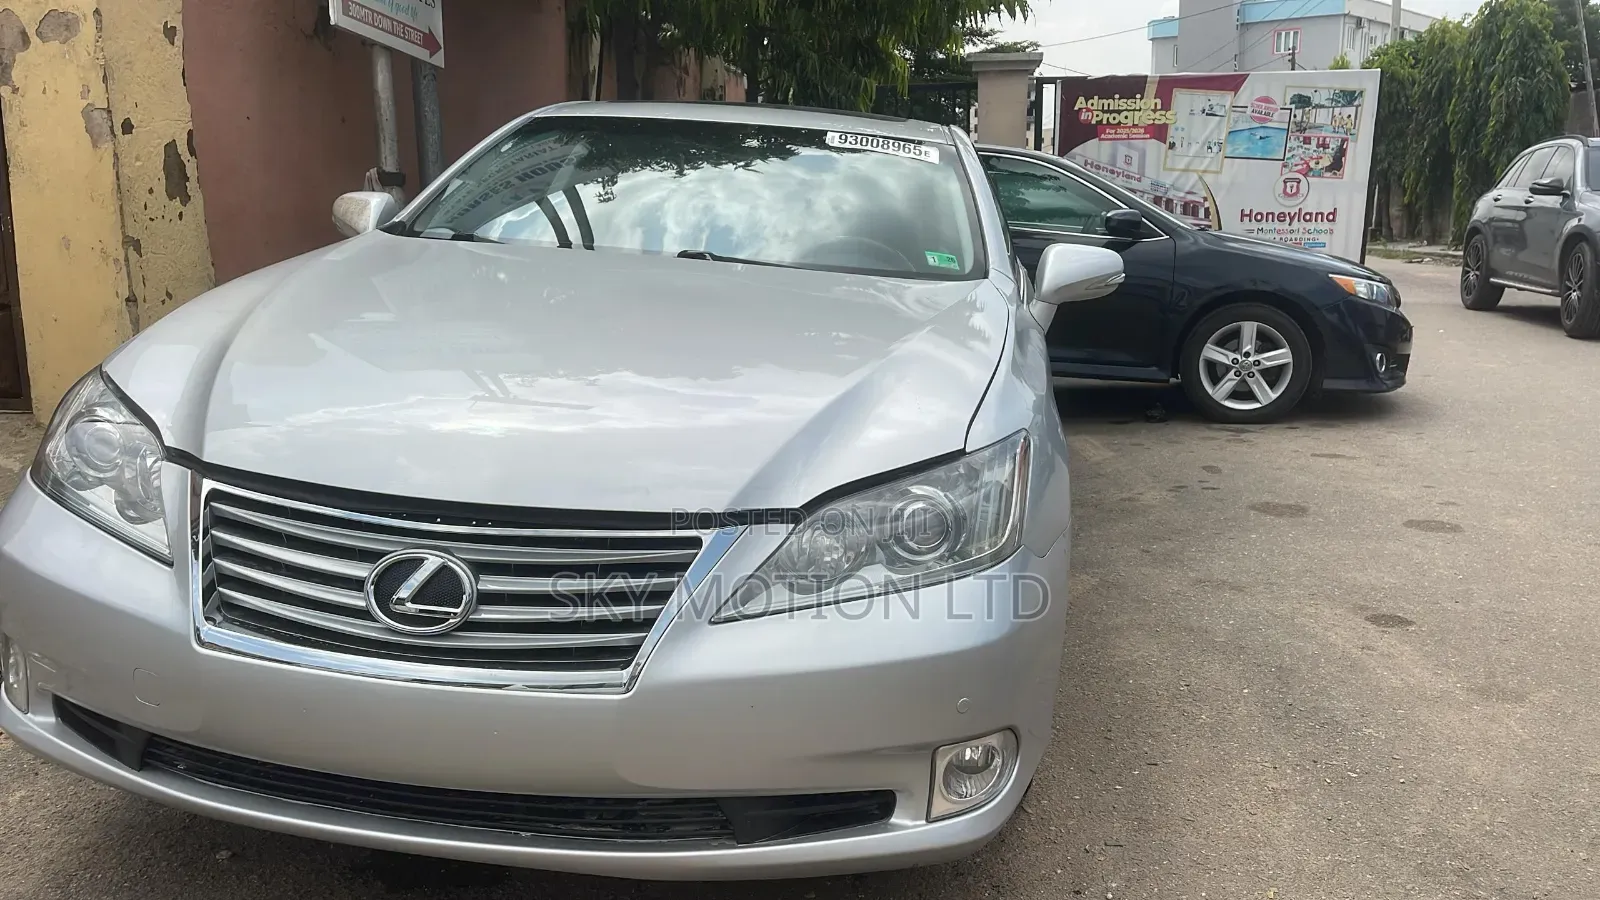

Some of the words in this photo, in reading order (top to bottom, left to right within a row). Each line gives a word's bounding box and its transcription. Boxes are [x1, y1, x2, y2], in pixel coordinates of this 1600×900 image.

[348, 1, 373, 25] 300MTR
[373, 12, 392, 33] DOWN
[392, 20, 405, 38] THE
[404, 26, 424, 46] STREET
[1074, 94, 1162, 110] Admission
[1080, 109, 1093, 120] in
[1091, 110, 1177, 126] Progress
[1083, 158, 1142, 182] Honeyland
[1240, 207, 1337, 226] Honeyland
[1256, 227, 1300, 235] Montessori
[1301, 227, 1334, 235] Schools
